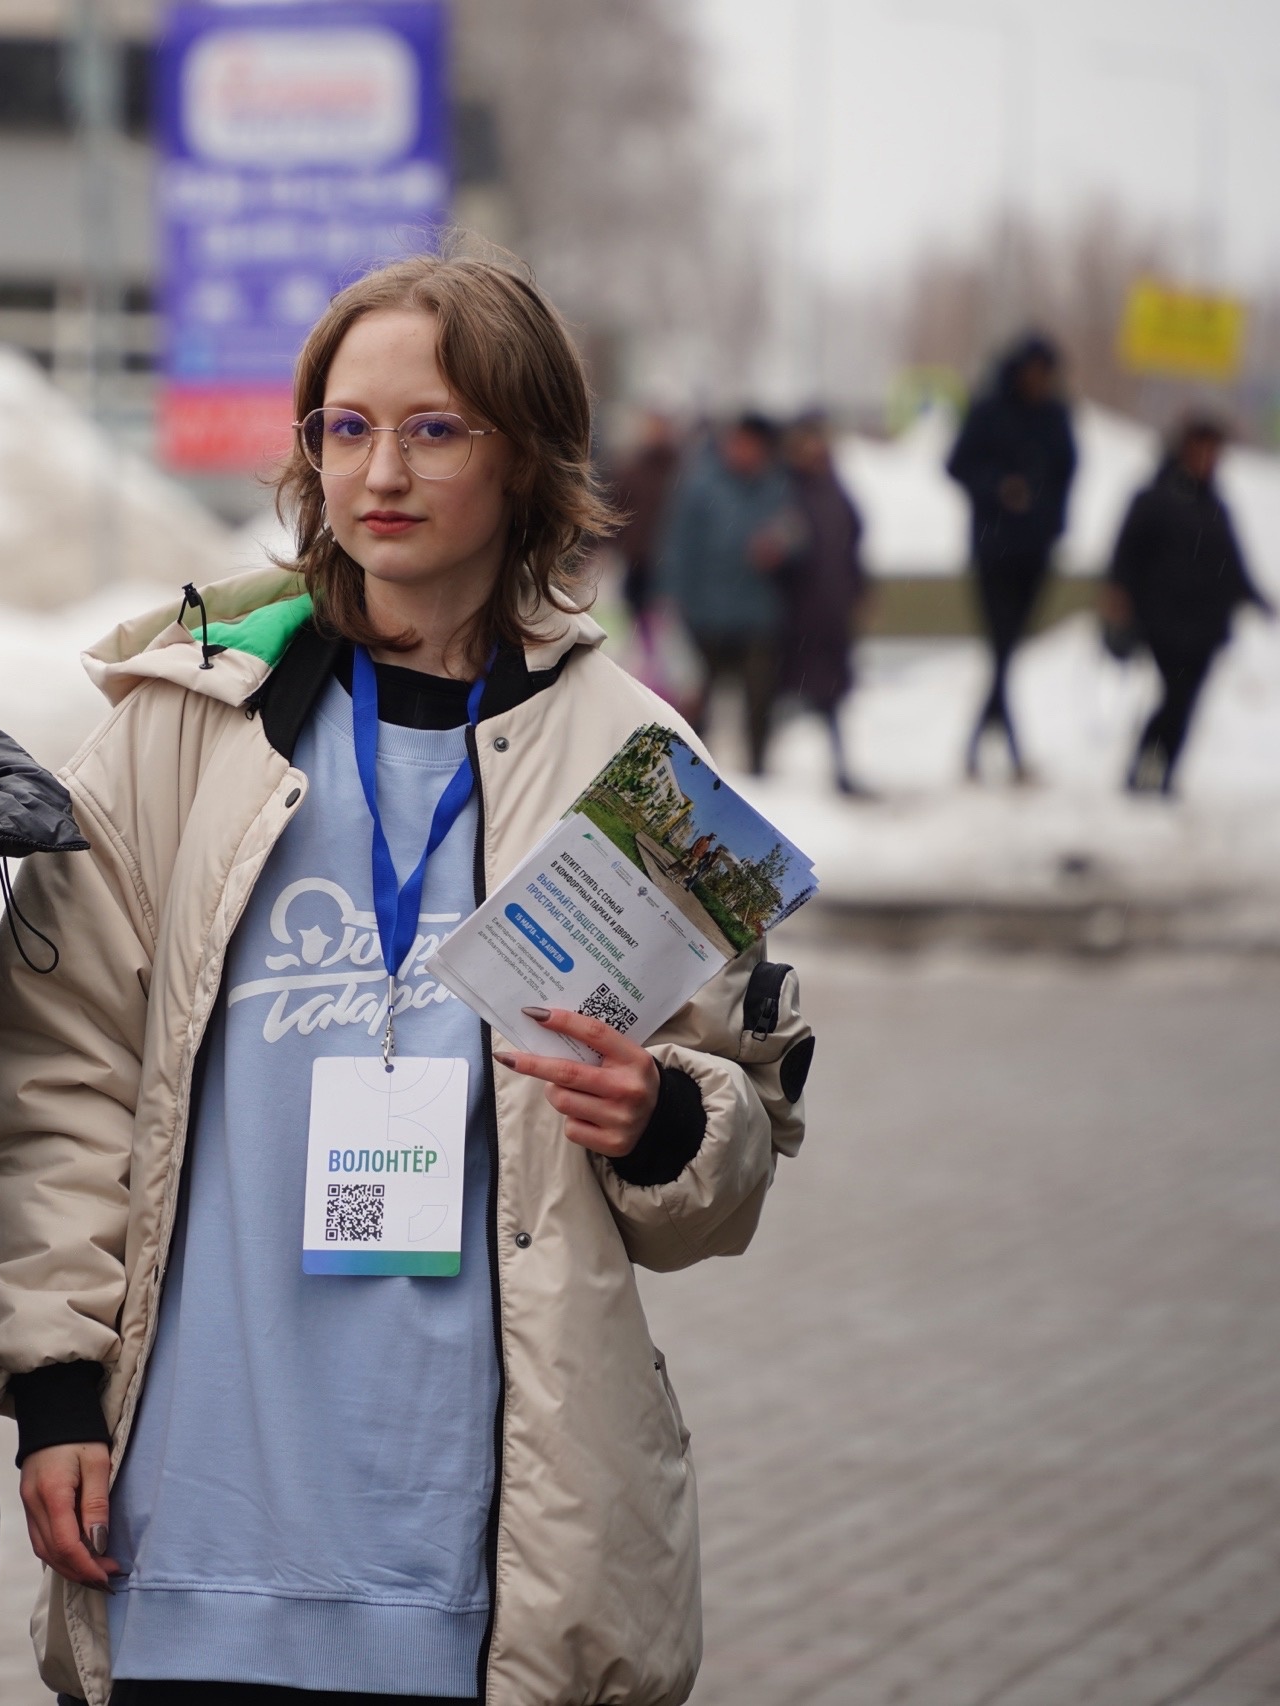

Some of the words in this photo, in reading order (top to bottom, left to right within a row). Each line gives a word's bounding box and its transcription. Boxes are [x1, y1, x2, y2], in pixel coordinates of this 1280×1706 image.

[550, 860, 557, 868] В
[554, 864, 592, 902] КОМФОРТНЫХ
[559, 851, 581, 872] ХОТИТЕ
[578, 869, 599, 891] ГУЛЯТЬ
[600, 892, 624, 915] СЕМЬЕЙ
[536, 872, 576, 913] ВЫБИРАЙТЕ
[572, 909, 625, 962] ОБЩЕСТВЕННЫЕ
[589, 899, 612, 922] ПАРКАХ
[609, 919, 616, 927] И
[612, 923, 638, 949] ДВОРАХ?
[484, 923, 518, 957] общественных
[517, 956, 545, 985] пространств
[491, 916, 516, 943] Ежегодное
[515, 941, 544, 971] голосование
[514, 912, 522, 921] 15
[519, 917, 537, 935] МАРТА
[538, 937, 547, 946] 30
[544, 943, 564, 963] АПРЕЛЯ
[525, 882, 575, 932] ПРОСТРАНСТВА
[570, 928, 589, 946] ДЛЯ
[584, 942, 645, 1003] БЛАГОУСТРОЙСТВА!
[486, 938, 524, 976] благоустройства
[526, 977, 539, 991] 2025
[328, 1145, 438, 1173] ВОЛОНТЁР
